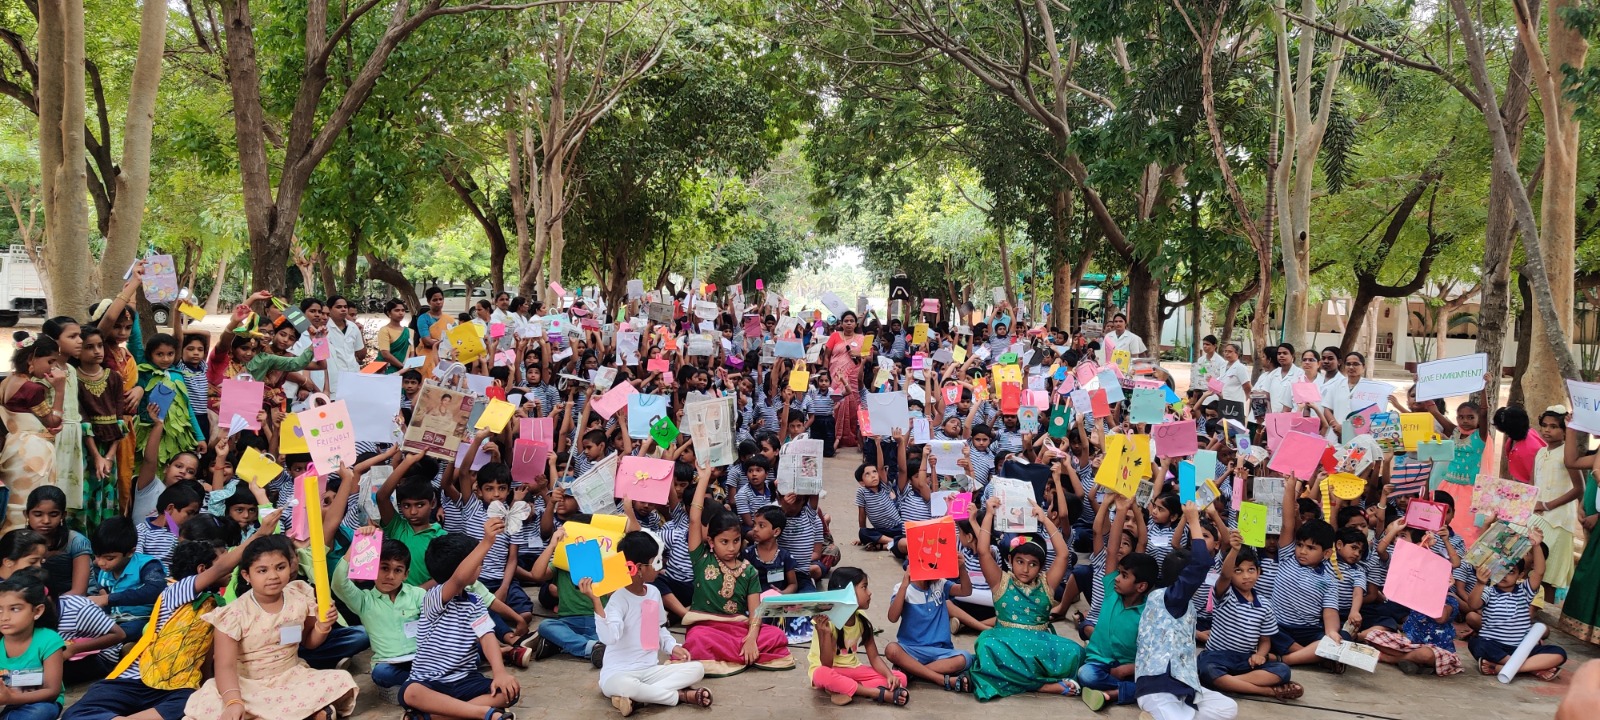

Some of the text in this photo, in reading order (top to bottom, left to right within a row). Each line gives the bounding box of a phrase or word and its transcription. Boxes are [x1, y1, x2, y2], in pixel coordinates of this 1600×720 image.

[1420, 373, 1435, 383] SAVE
[1401, 424, 1419, 432] RTH
[317, 432, 349, 447] FRIENDLY
